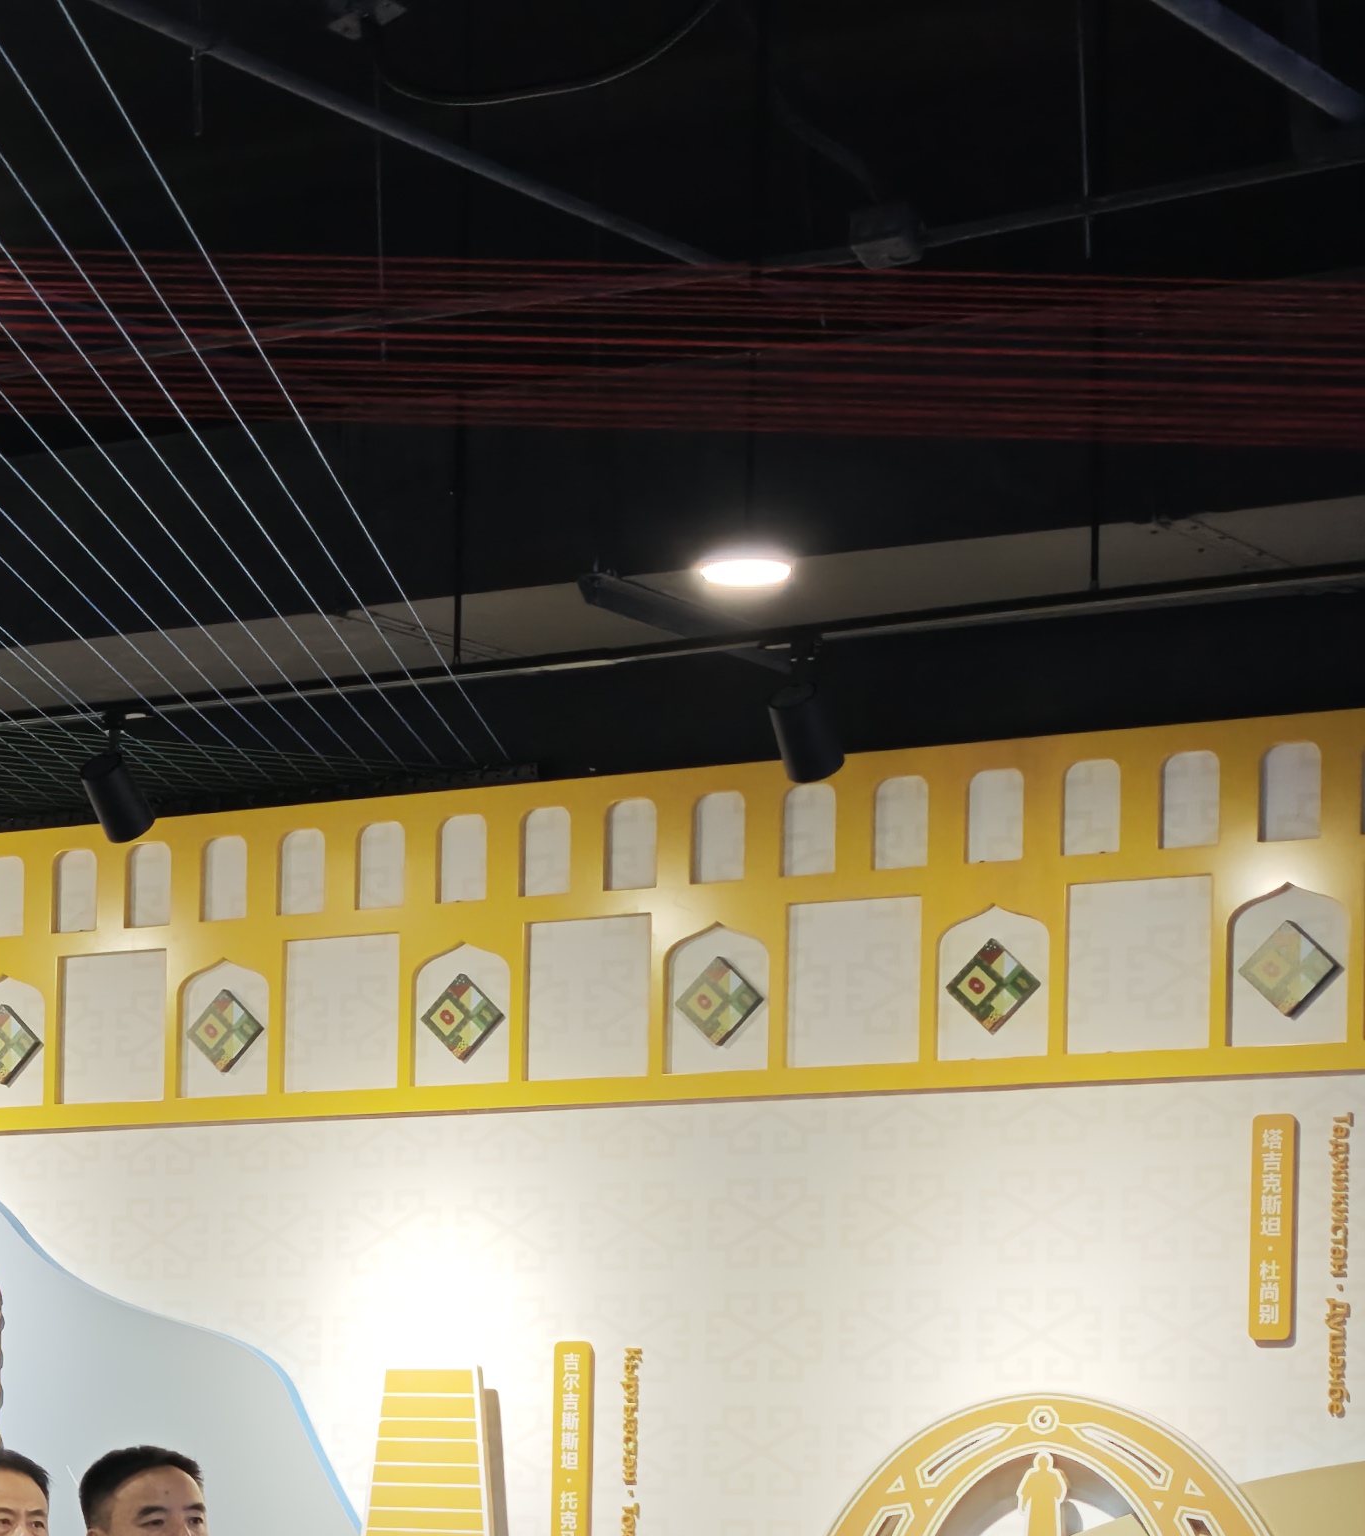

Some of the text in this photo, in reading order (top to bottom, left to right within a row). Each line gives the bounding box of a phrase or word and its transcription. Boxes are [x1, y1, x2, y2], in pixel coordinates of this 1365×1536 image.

[1259, 1129, 1283, 1324] 塔吉克斯坦·杜尚别
[1325, 1112, 1354, 1418] Таджикистан Душанбе
